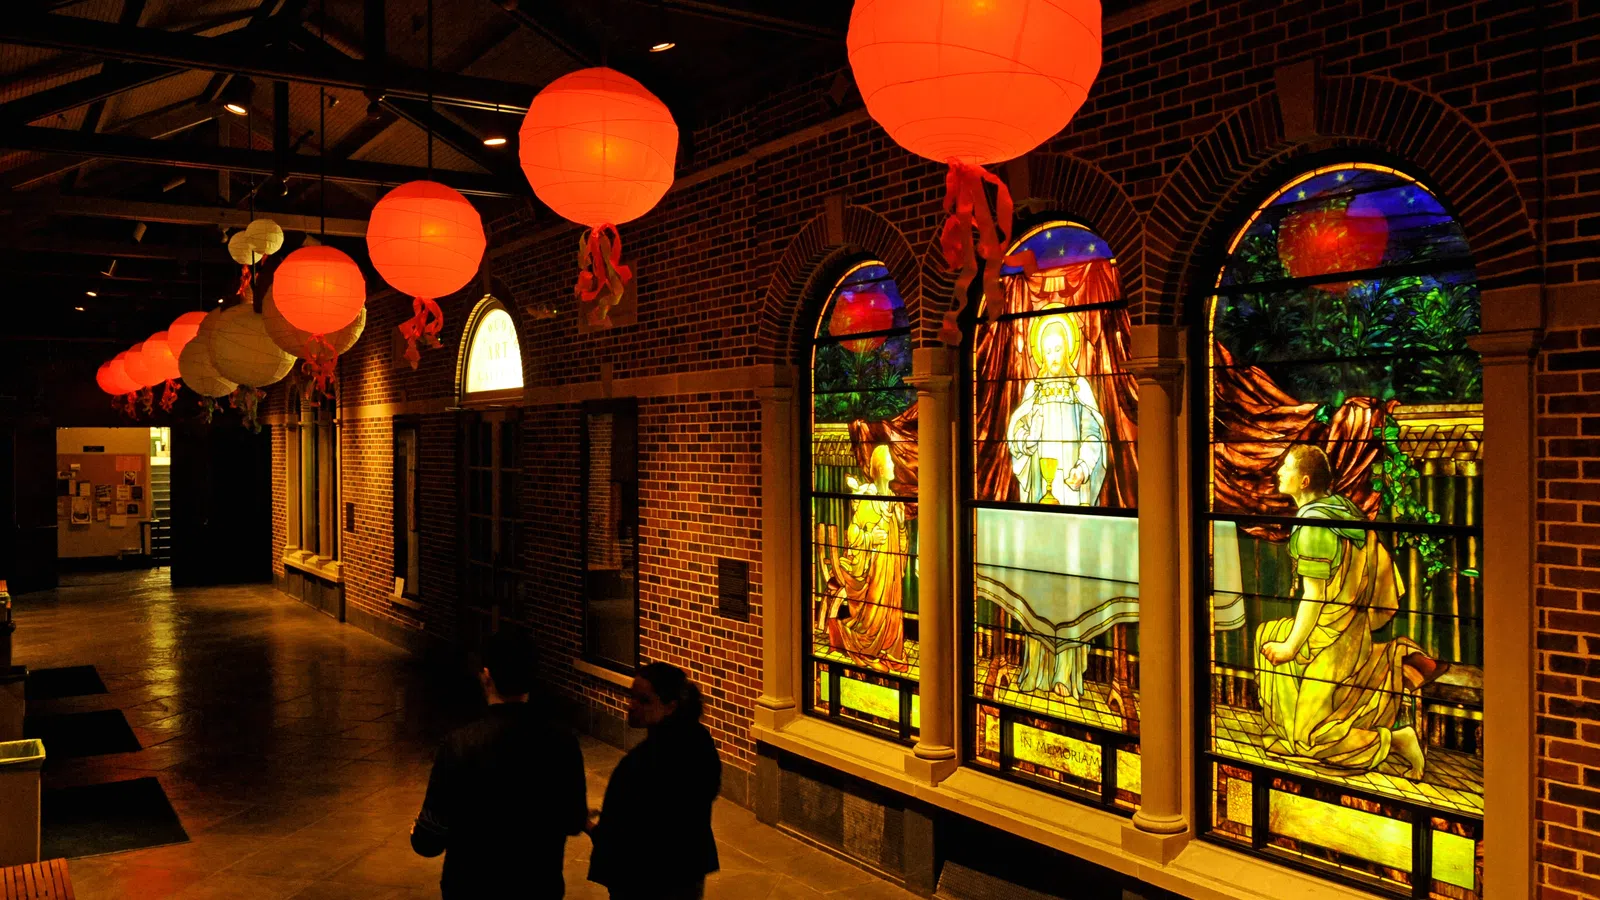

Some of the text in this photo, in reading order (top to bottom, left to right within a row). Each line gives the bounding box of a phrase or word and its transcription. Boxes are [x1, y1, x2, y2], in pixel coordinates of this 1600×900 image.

[487, 341, 509, 361] ART
[1020, 735, 1100, 767] IN MEMORIAM
